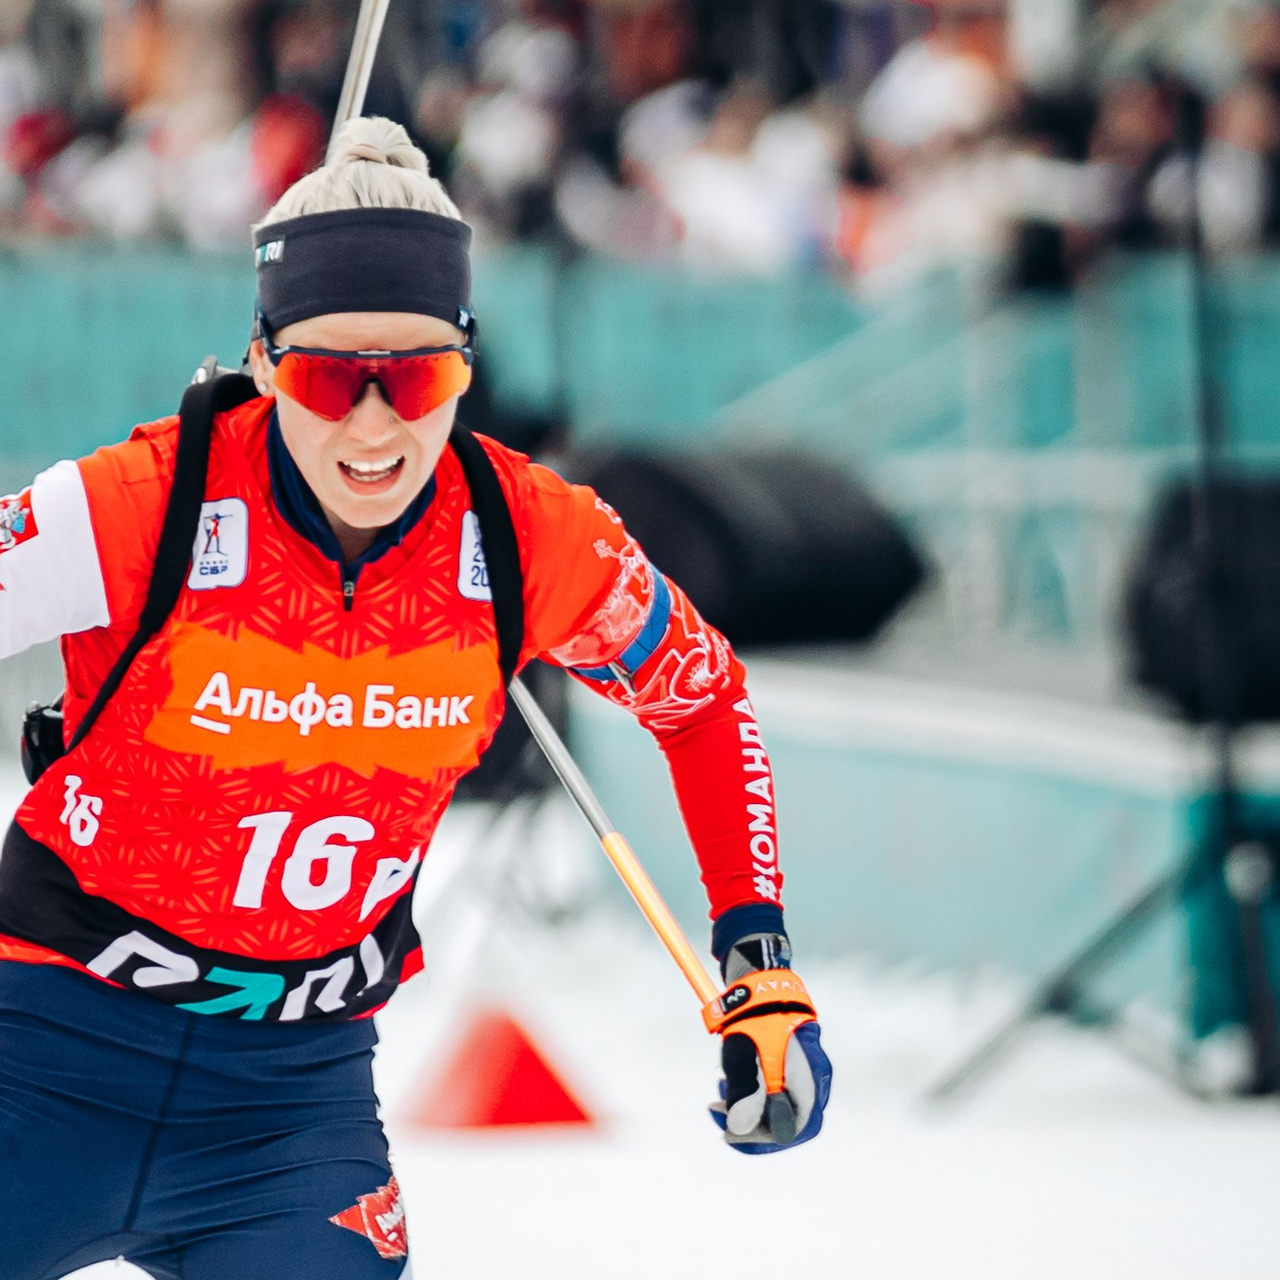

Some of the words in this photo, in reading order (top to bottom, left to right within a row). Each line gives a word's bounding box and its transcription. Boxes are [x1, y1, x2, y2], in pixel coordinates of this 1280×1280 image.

[191, 672, 353, 736] Альфа
[363, 685, 474, 729] Банк
[59, 774, 103, 847] 16
[232, 811, 375, 911] 16
